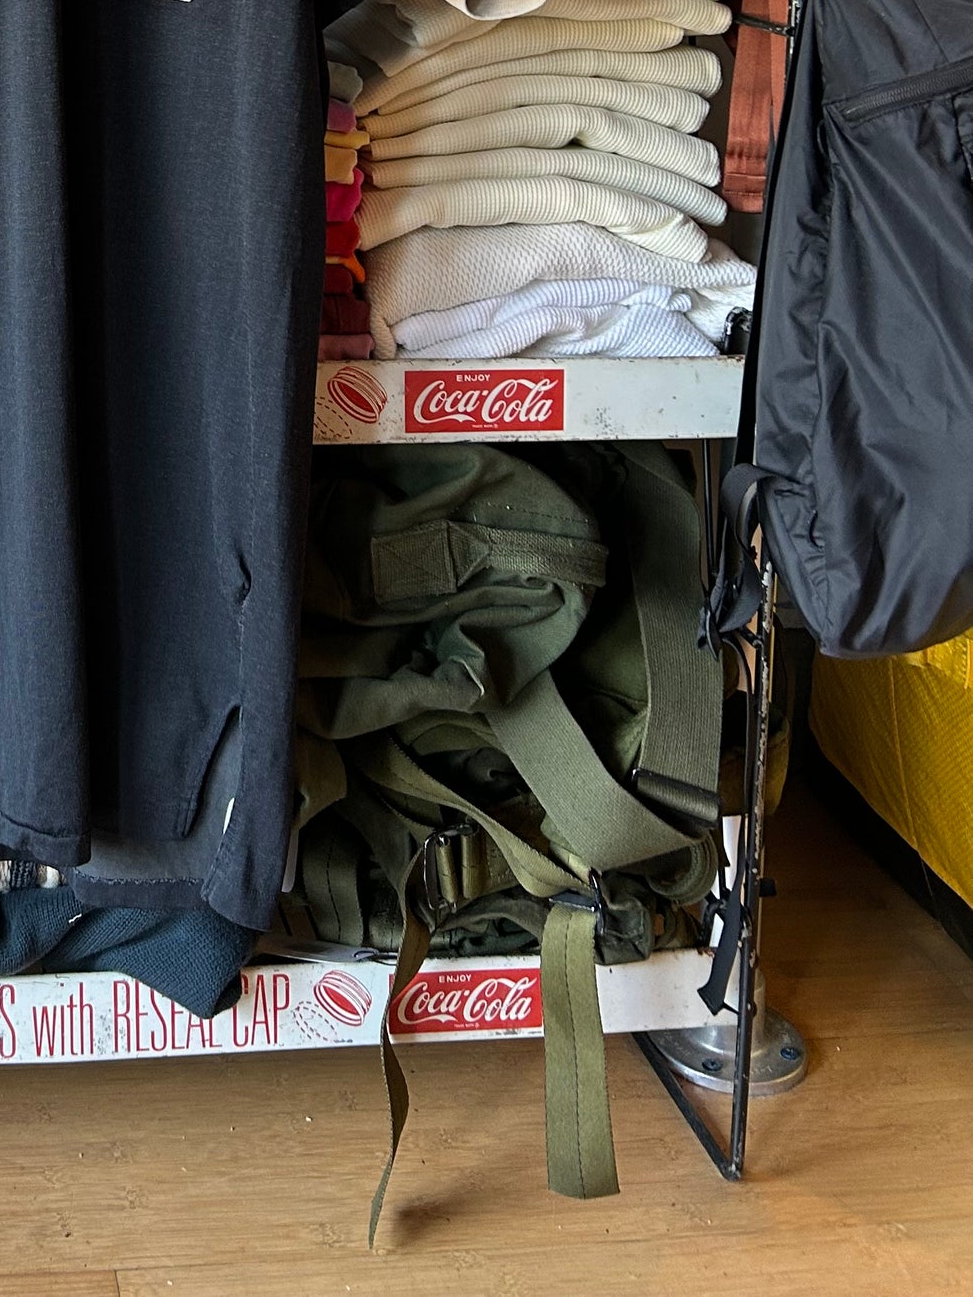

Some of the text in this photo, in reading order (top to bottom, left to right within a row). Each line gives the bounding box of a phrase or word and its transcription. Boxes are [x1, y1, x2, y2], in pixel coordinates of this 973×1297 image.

[456, 374, 490, 382] ENJOY
[413, 379, 558, 423] Coca-Cola
[397, 976, 537, 1025] Coca-Cola
[439, 974, 472, 983] ENJOY
[32, 981, 94, 1056] with
[231, 973, 290, 1048] CAP
